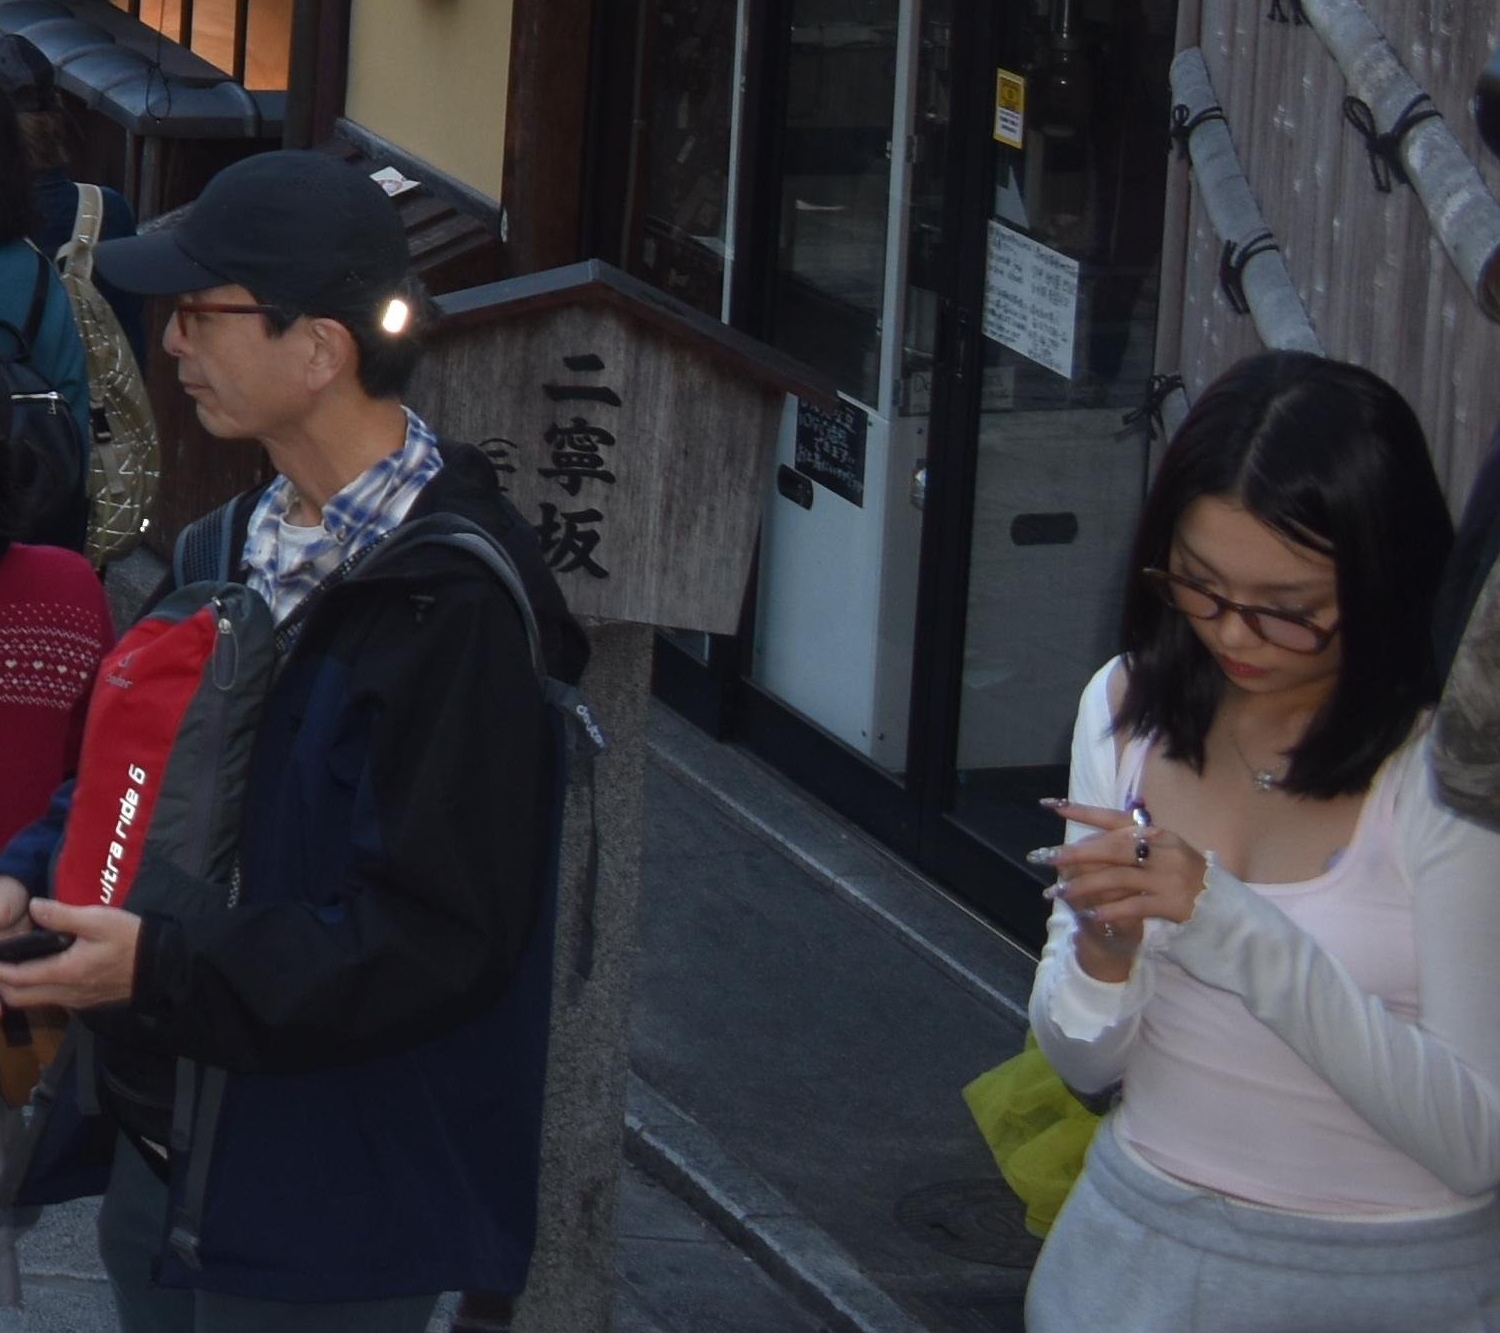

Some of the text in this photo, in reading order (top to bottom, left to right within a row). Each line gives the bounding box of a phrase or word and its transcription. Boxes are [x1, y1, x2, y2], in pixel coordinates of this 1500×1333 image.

[534, 352, 622, 580] 二寧坂
[100, 763, 147, 907] ultra ride 6
